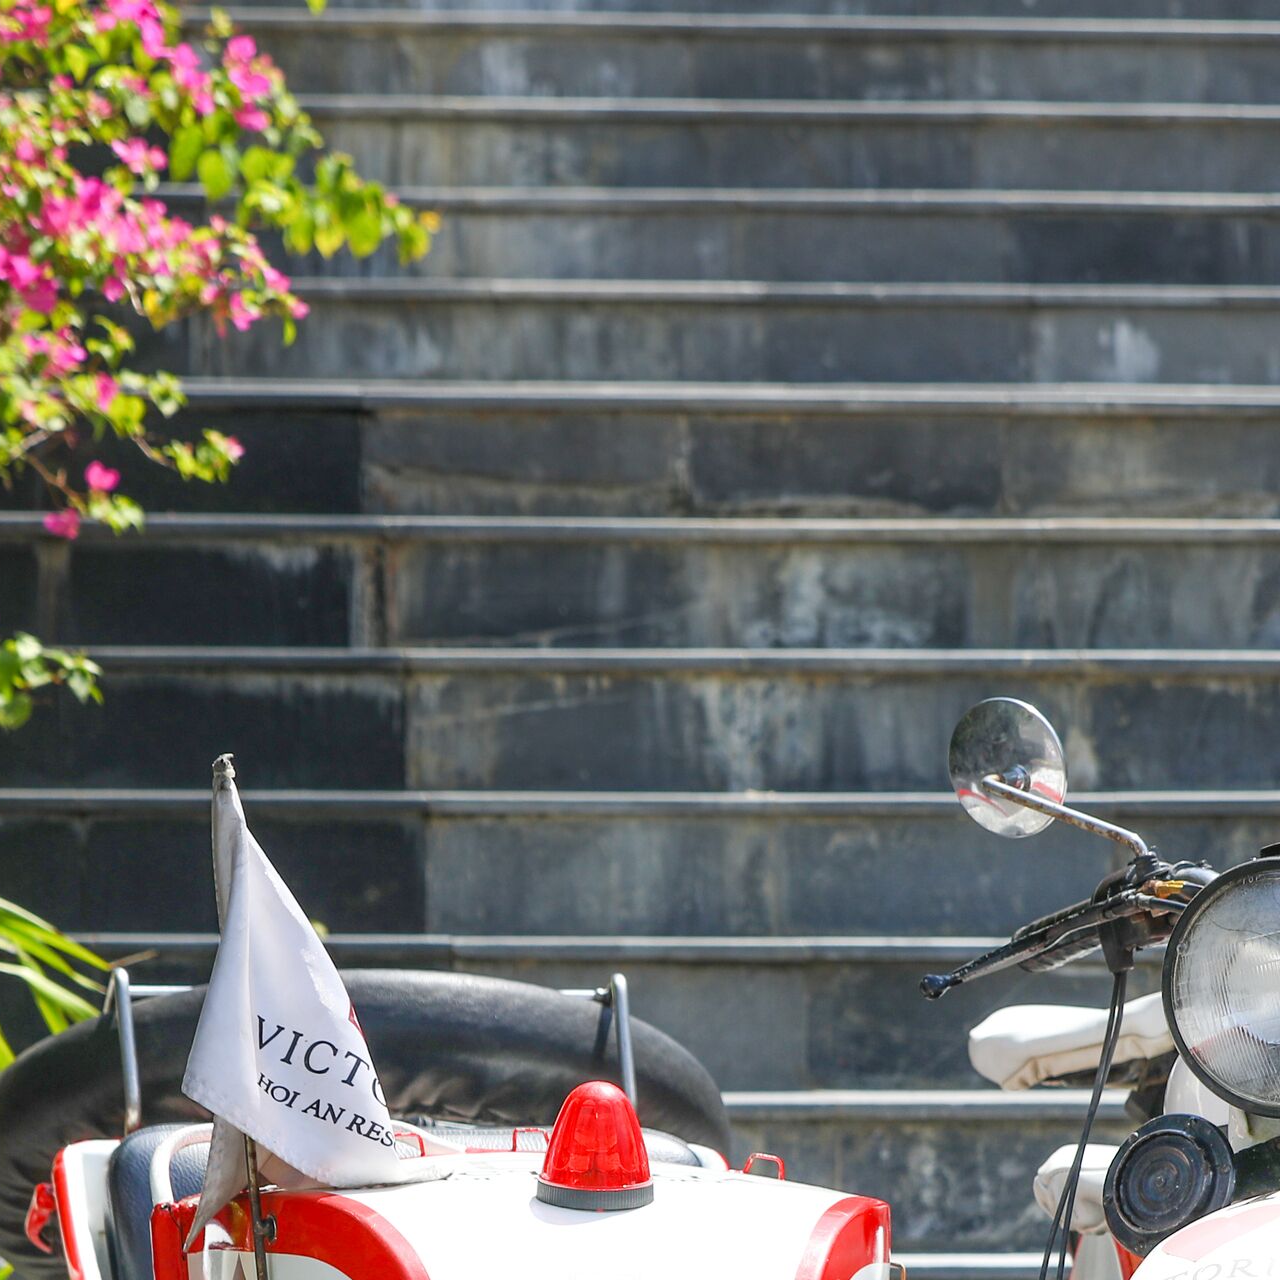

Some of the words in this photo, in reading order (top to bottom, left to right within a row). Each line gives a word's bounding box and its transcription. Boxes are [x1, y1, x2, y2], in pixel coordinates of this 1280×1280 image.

[257, 1072, 300, 1108] HOI
[301, 1098, 346, 1125] AN
[345, 1113, 397, 1150] RES
